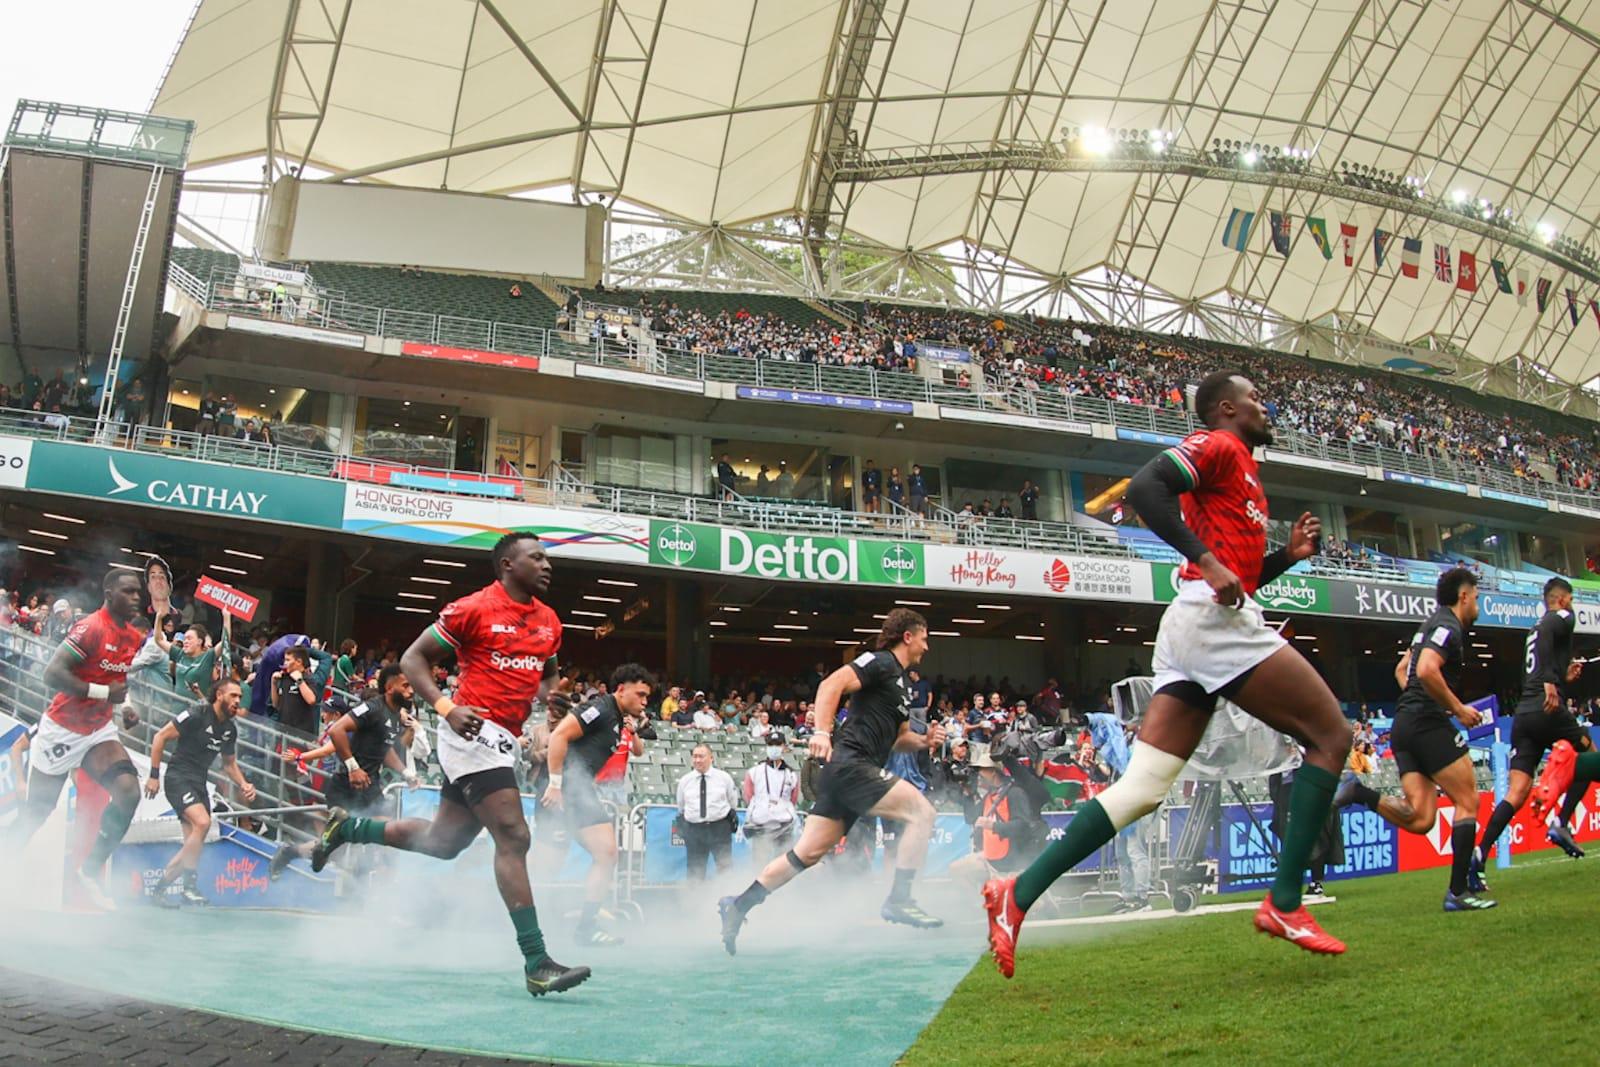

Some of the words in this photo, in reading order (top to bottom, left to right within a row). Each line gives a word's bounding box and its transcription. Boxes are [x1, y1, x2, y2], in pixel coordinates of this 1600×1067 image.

[147, 479, 268, 515] CATHAY
[355, 488, 402, 506] HONG
[405, 496, 453, 513] KONG
[355, 501, 388, 512] ASIA'S
[390, 504, 426, 518] WORLD
[427, 510, 451, 520] CITY
[659, 536, 694, 552] Dettol
[720, 528, 858, 582] Dettol
[883, 555, 914, 570] Dettol
[965, 550, 1006, 570] Hello
[950, 563, 984, 587] Hong
[986, 565, 1016, 589] Kong
[1072, 561, 1102, 573] HONG
[1103, 563, 1131, 575] KONG
[1073, 571, 1106, 582] TOURISM
[1106, 574, 1132, 584] BOARD
[1483, 596, 1537, 624] Capgemini
[225, 856, 260, 878] Hello
